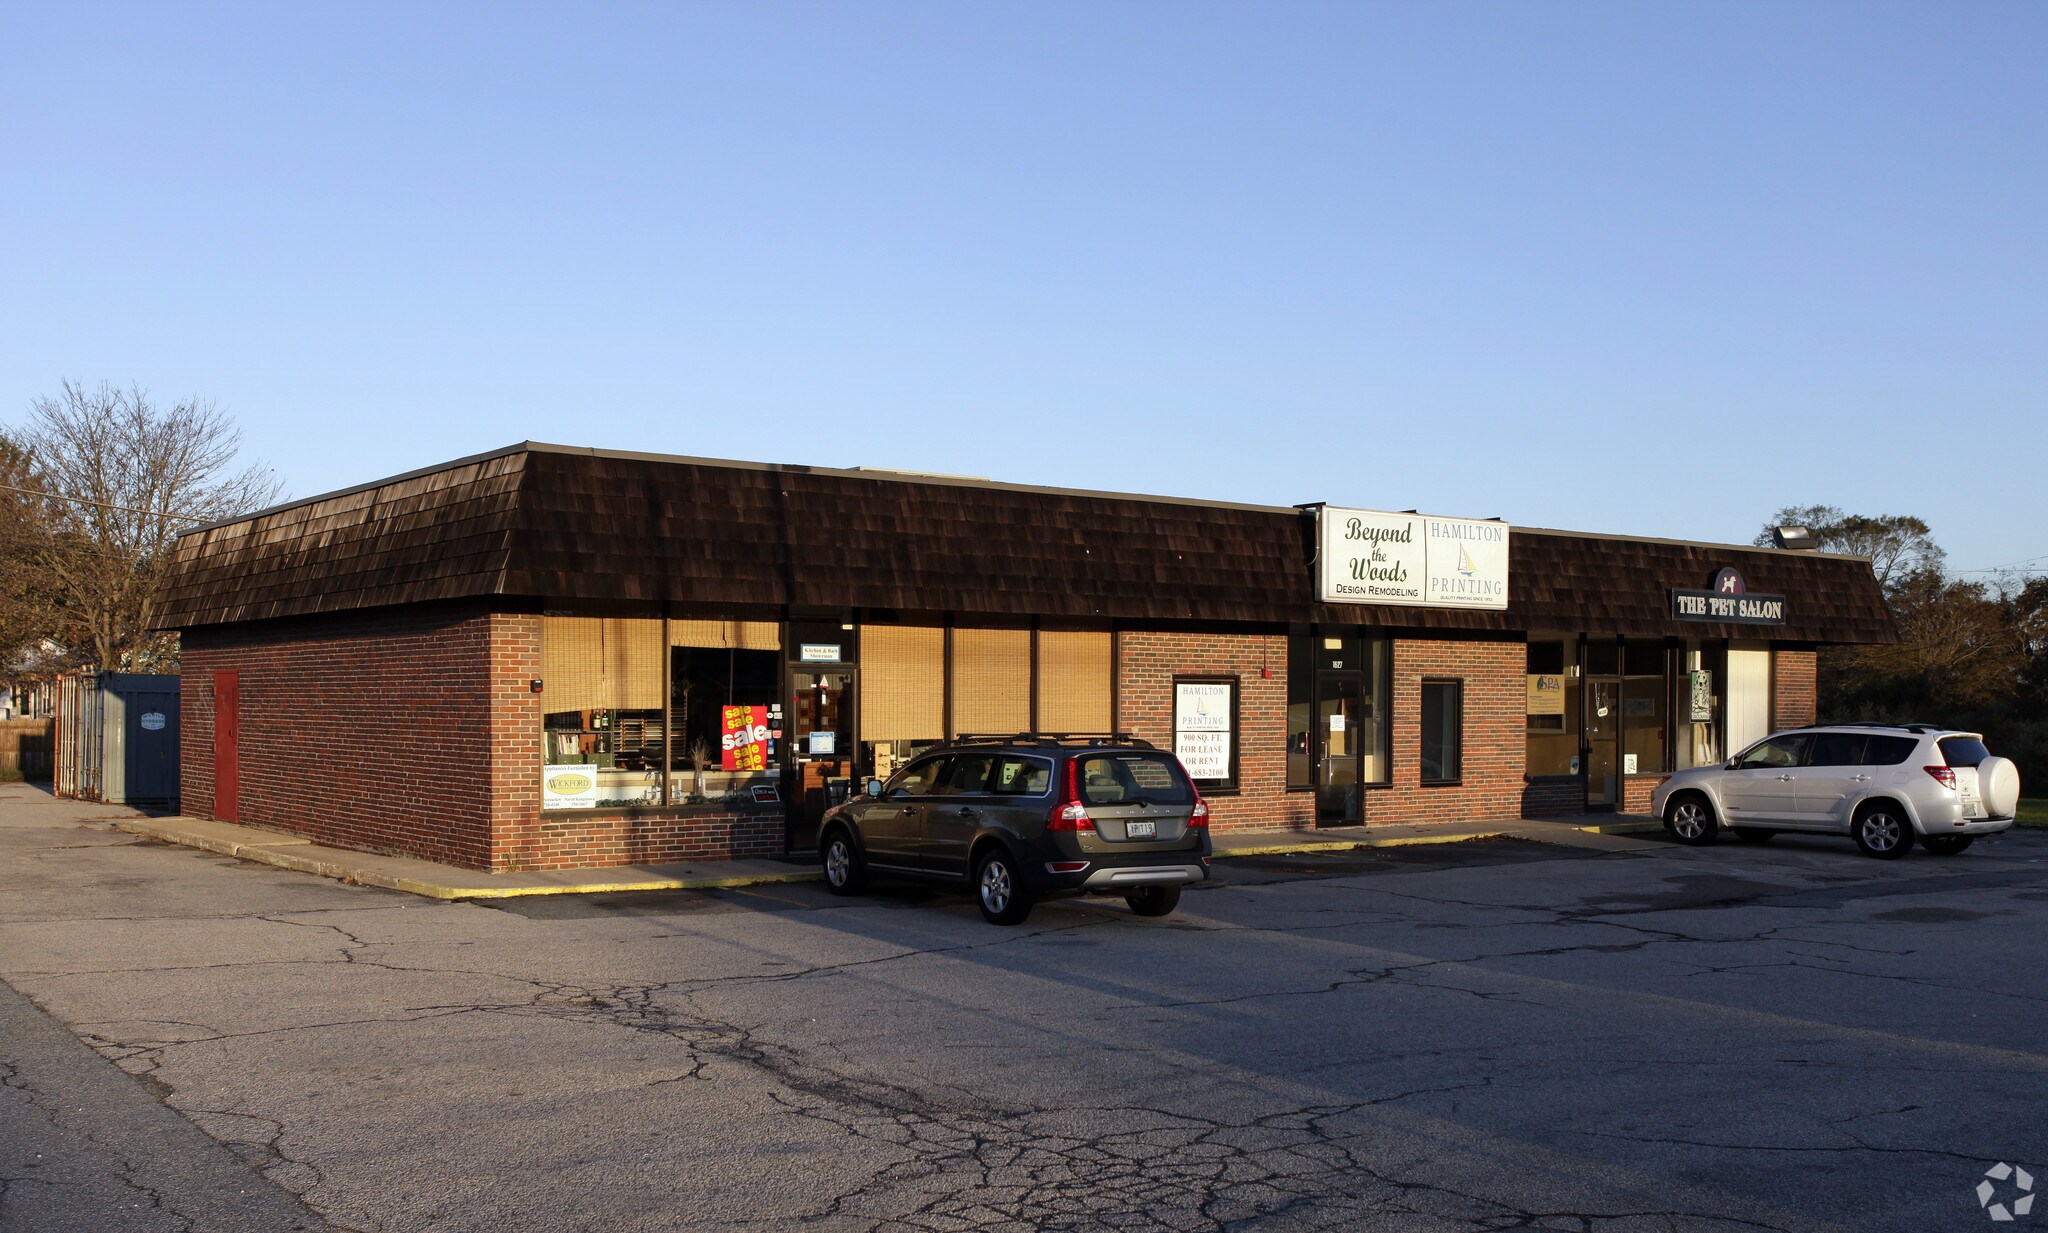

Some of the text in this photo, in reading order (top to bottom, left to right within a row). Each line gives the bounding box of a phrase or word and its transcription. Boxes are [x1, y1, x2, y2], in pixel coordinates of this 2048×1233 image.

[1345, 518, 1412, 548] Beyond
[1432, 523, 1502, 541] HAMILTON
[1372, 548, 1387, 562] the
[1350, 557, 1407, 582] Woods
[1336, 584, 1418, 597] DESIGN REMODELING
[1432, 578, 1502, 595] PRINTING
[1677, 595, 1782, 619] THE PET SALON
[1183, 686, 1224, 696] HAMILTON
[724, 706, 752, 719] sale
[727, 715, 754, 729] sale
[1182, 716, 1224, 725] PRINTING
[722, 724, 768, 750] sale
[1183, 733, 1195, 741] 900
[1197, 734, 1209, 743] SQ.
[733, 744, 760, 758] sale
[1180, 745, 1223, 753] FOR LEASE
[735, 755, 762, 768] sale
[1185, 757, 1219, 765] OR RENT
[549, 779, 589, 789] WICKFORD
